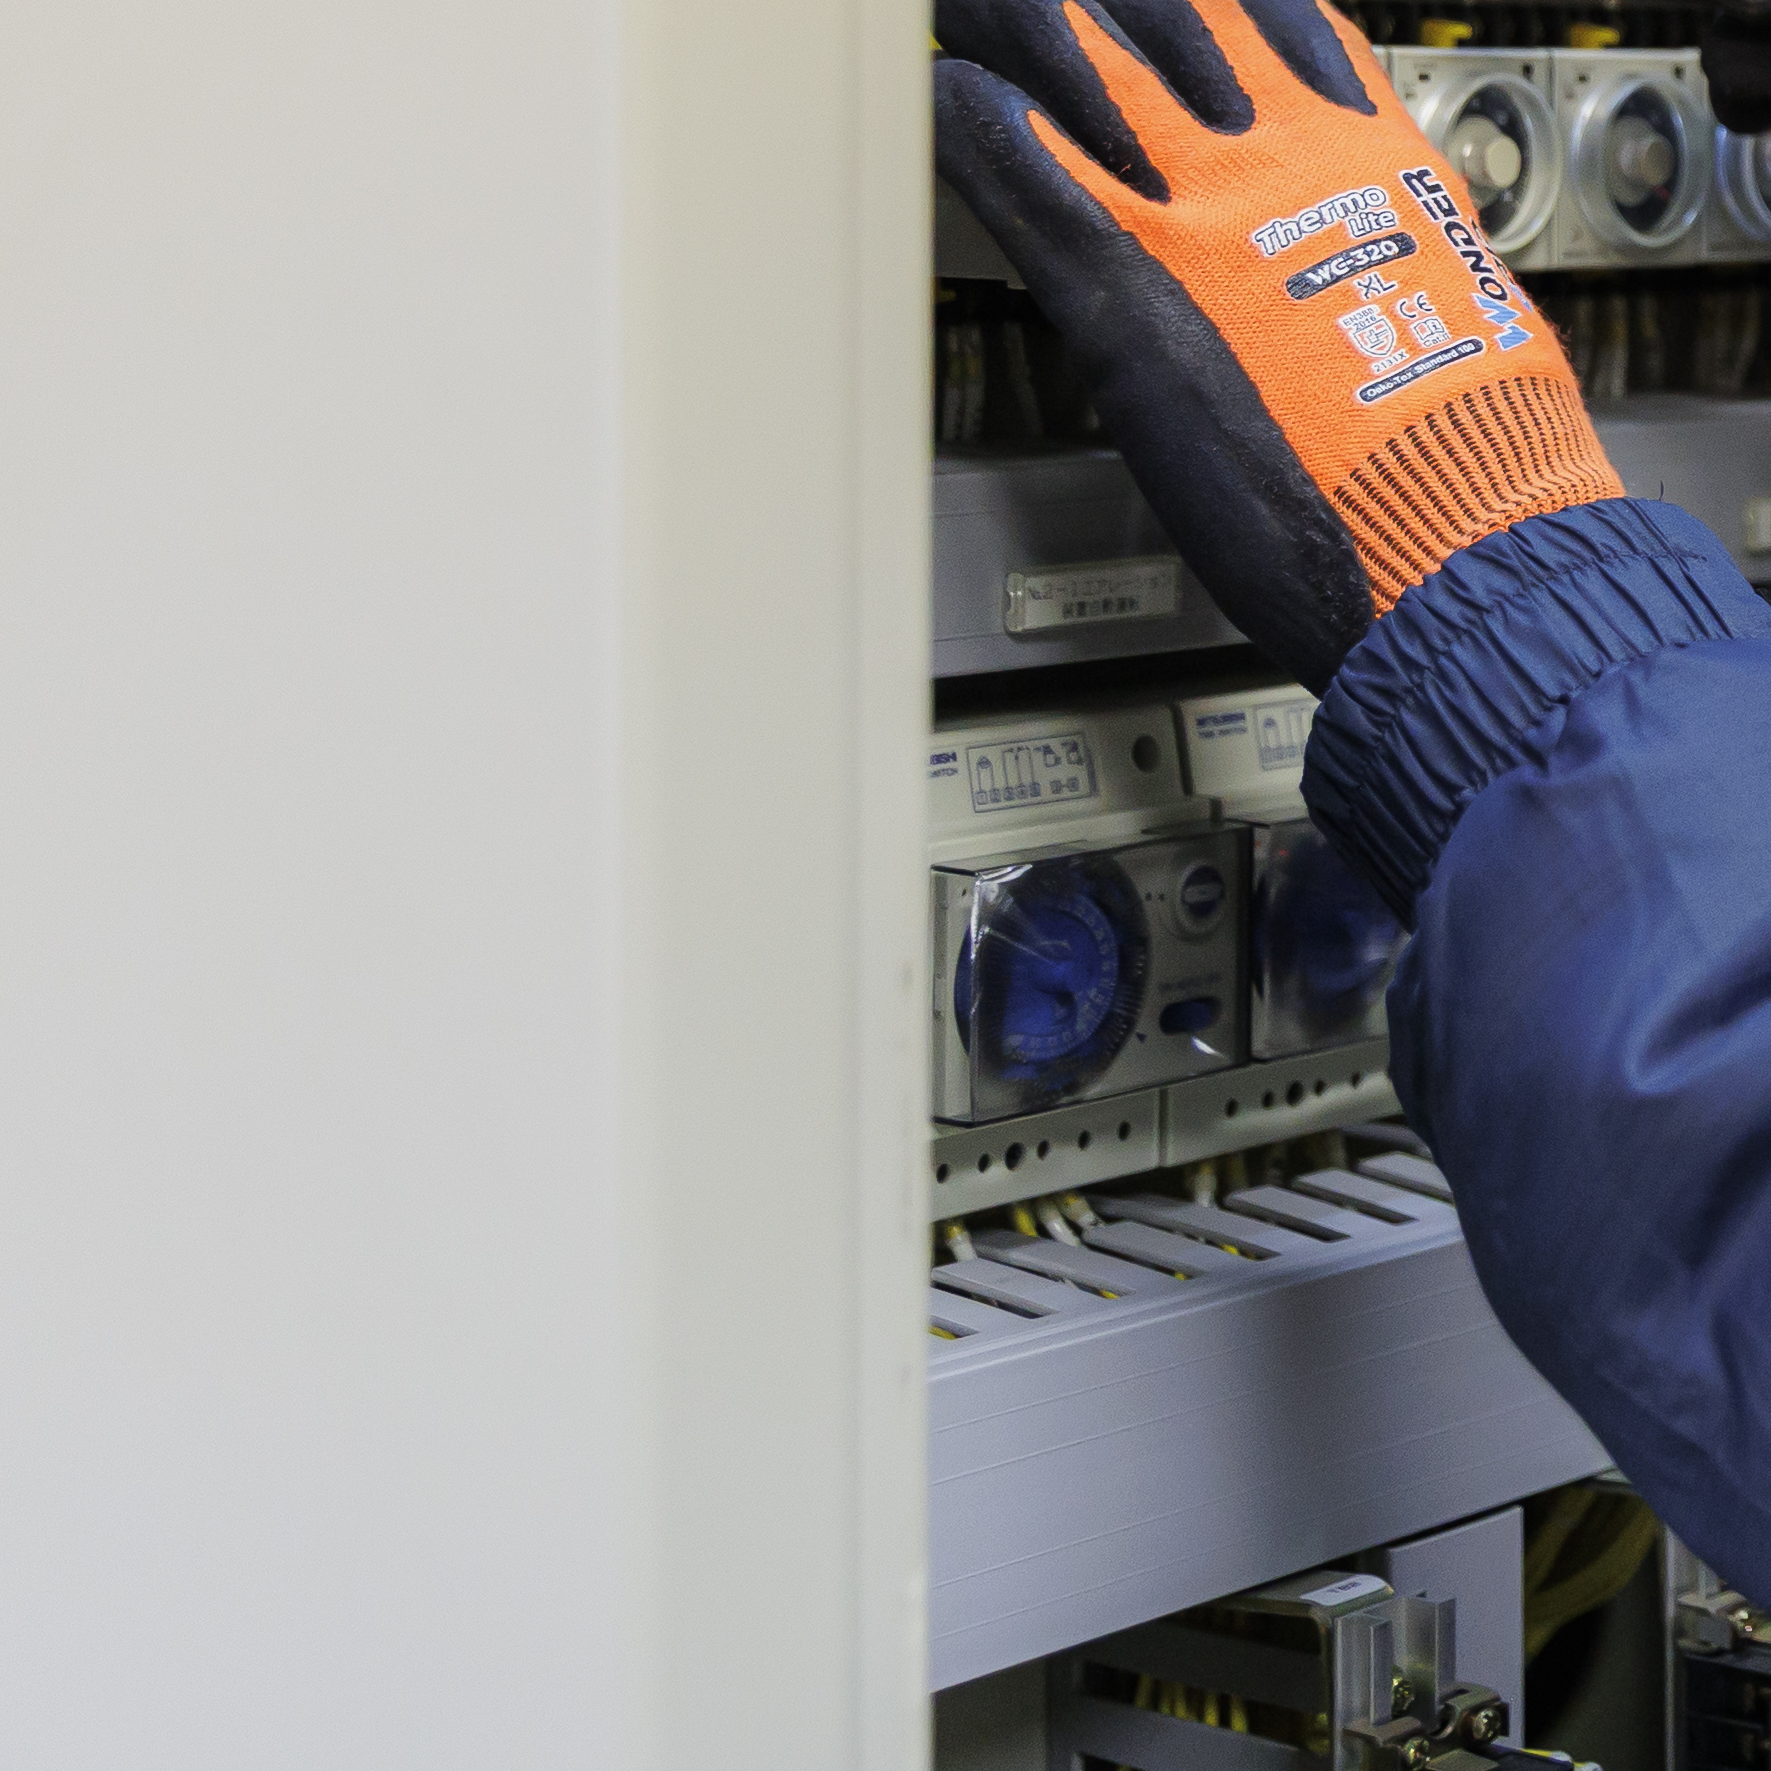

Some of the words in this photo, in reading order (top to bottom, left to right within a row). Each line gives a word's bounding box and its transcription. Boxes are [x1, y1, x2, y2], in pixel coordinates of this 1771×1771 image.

[1255, 187, 1387, 256] Thermo
[1348, 211, 1397, 238] Lite
[1402, 168, 1534, 351] WONDER
[1357, 273, 1397, 300] XL
[1353, 315, 1378, 332] 2016
[1413, 350, 1459, 375] Standard
